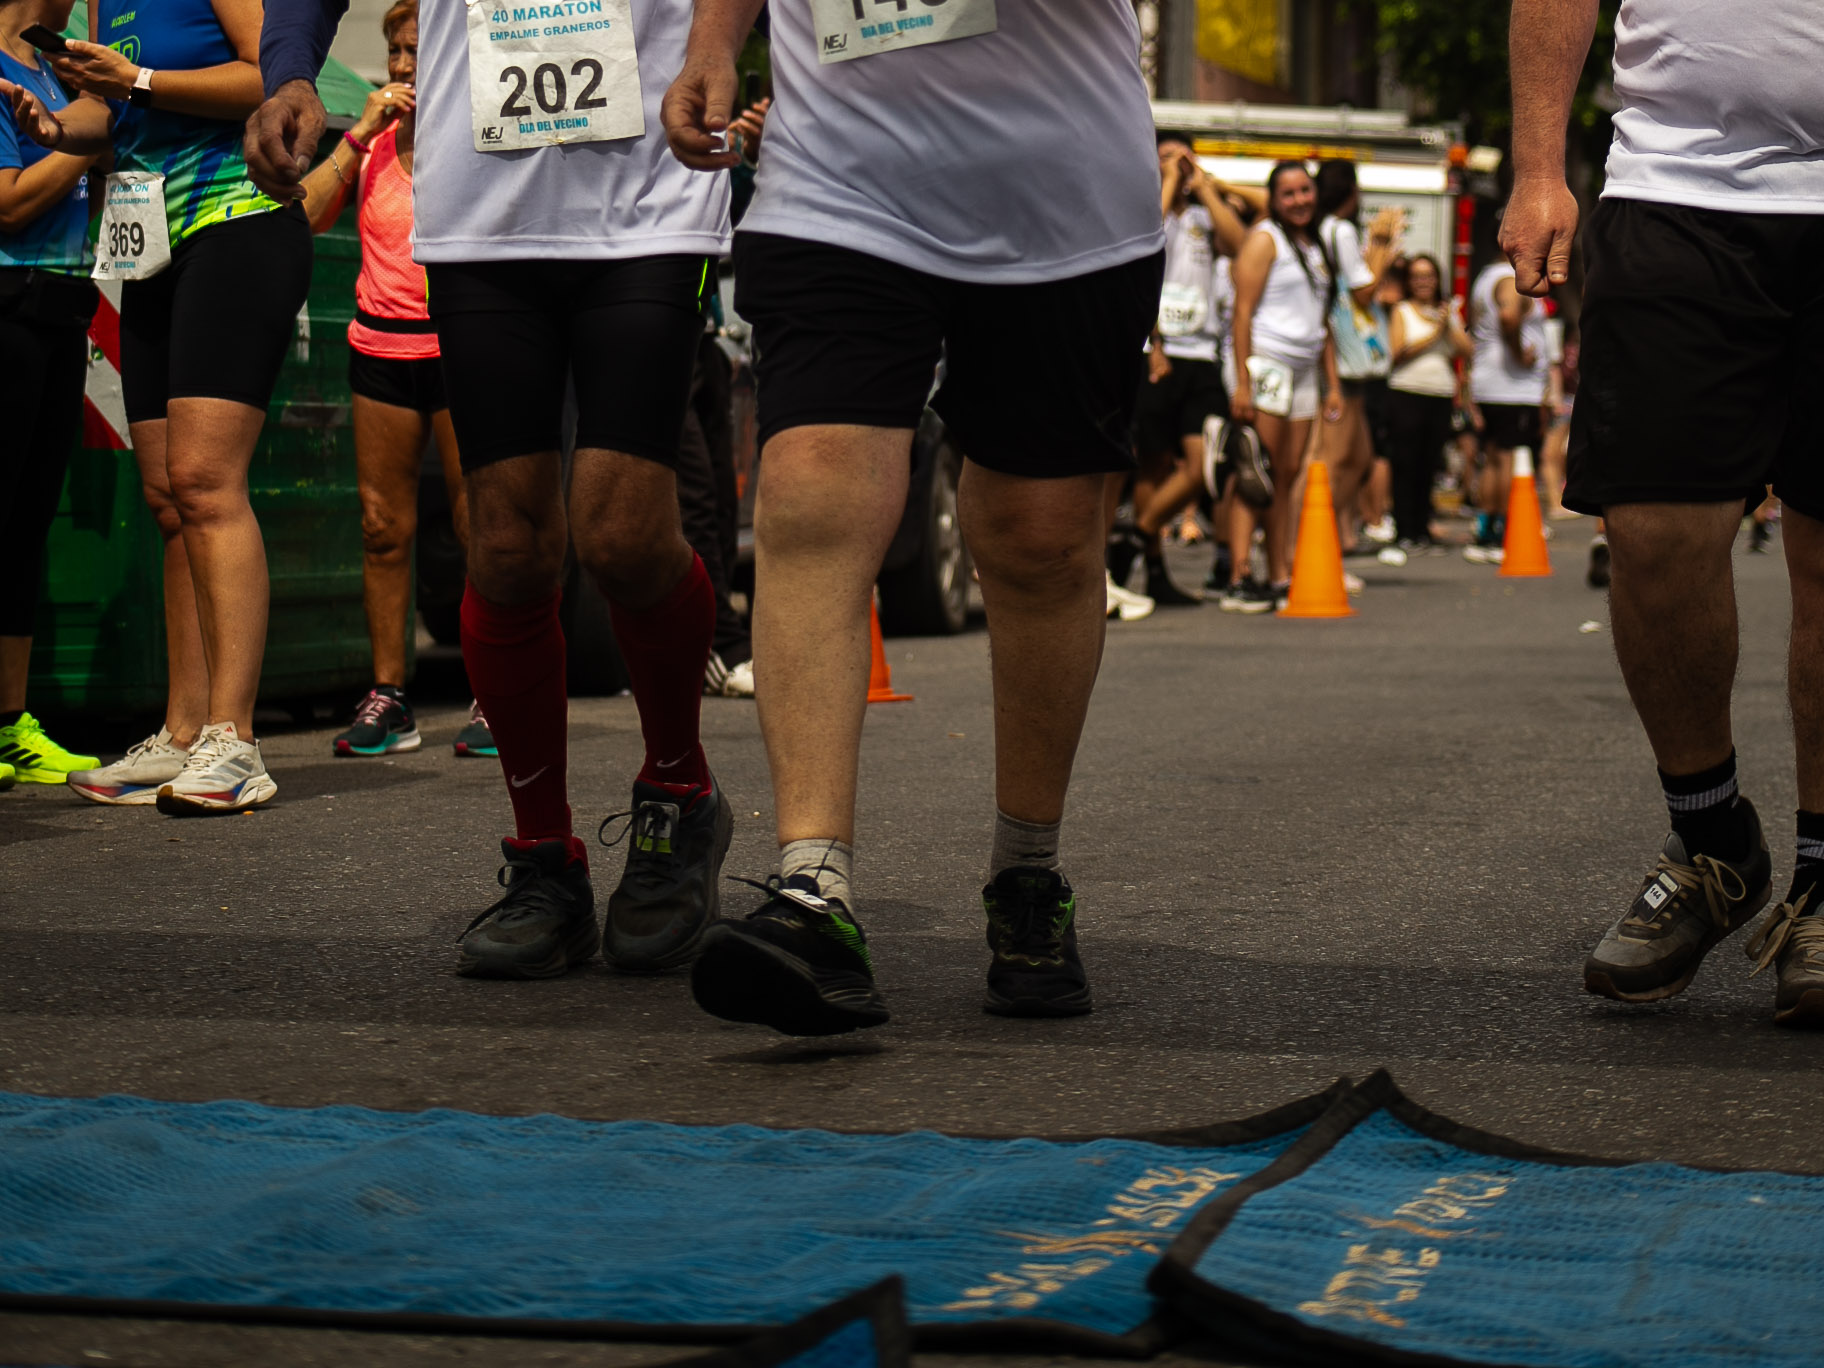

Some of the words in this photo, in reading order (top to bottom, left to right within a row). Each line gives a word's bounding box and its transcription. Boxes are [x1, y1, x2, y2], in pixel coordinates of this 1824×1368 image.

[492, 9, 509, 23] 40
[513, 0, 602, 22] MARATON
[490, 28, 539, 42] EMPALME
[543, 19, 611, 36] GRANEROS
[823, 33, 847, 51] NEJ
[499, 58, 608, 118] 202
[481, 126, 504, 140] NEJ
[519, 122, 535, 134] DIA
[537, 121, 553, 132] DEL
[554, 117, 588, 130] VECINO
[109, 221, 145, 258] 369
